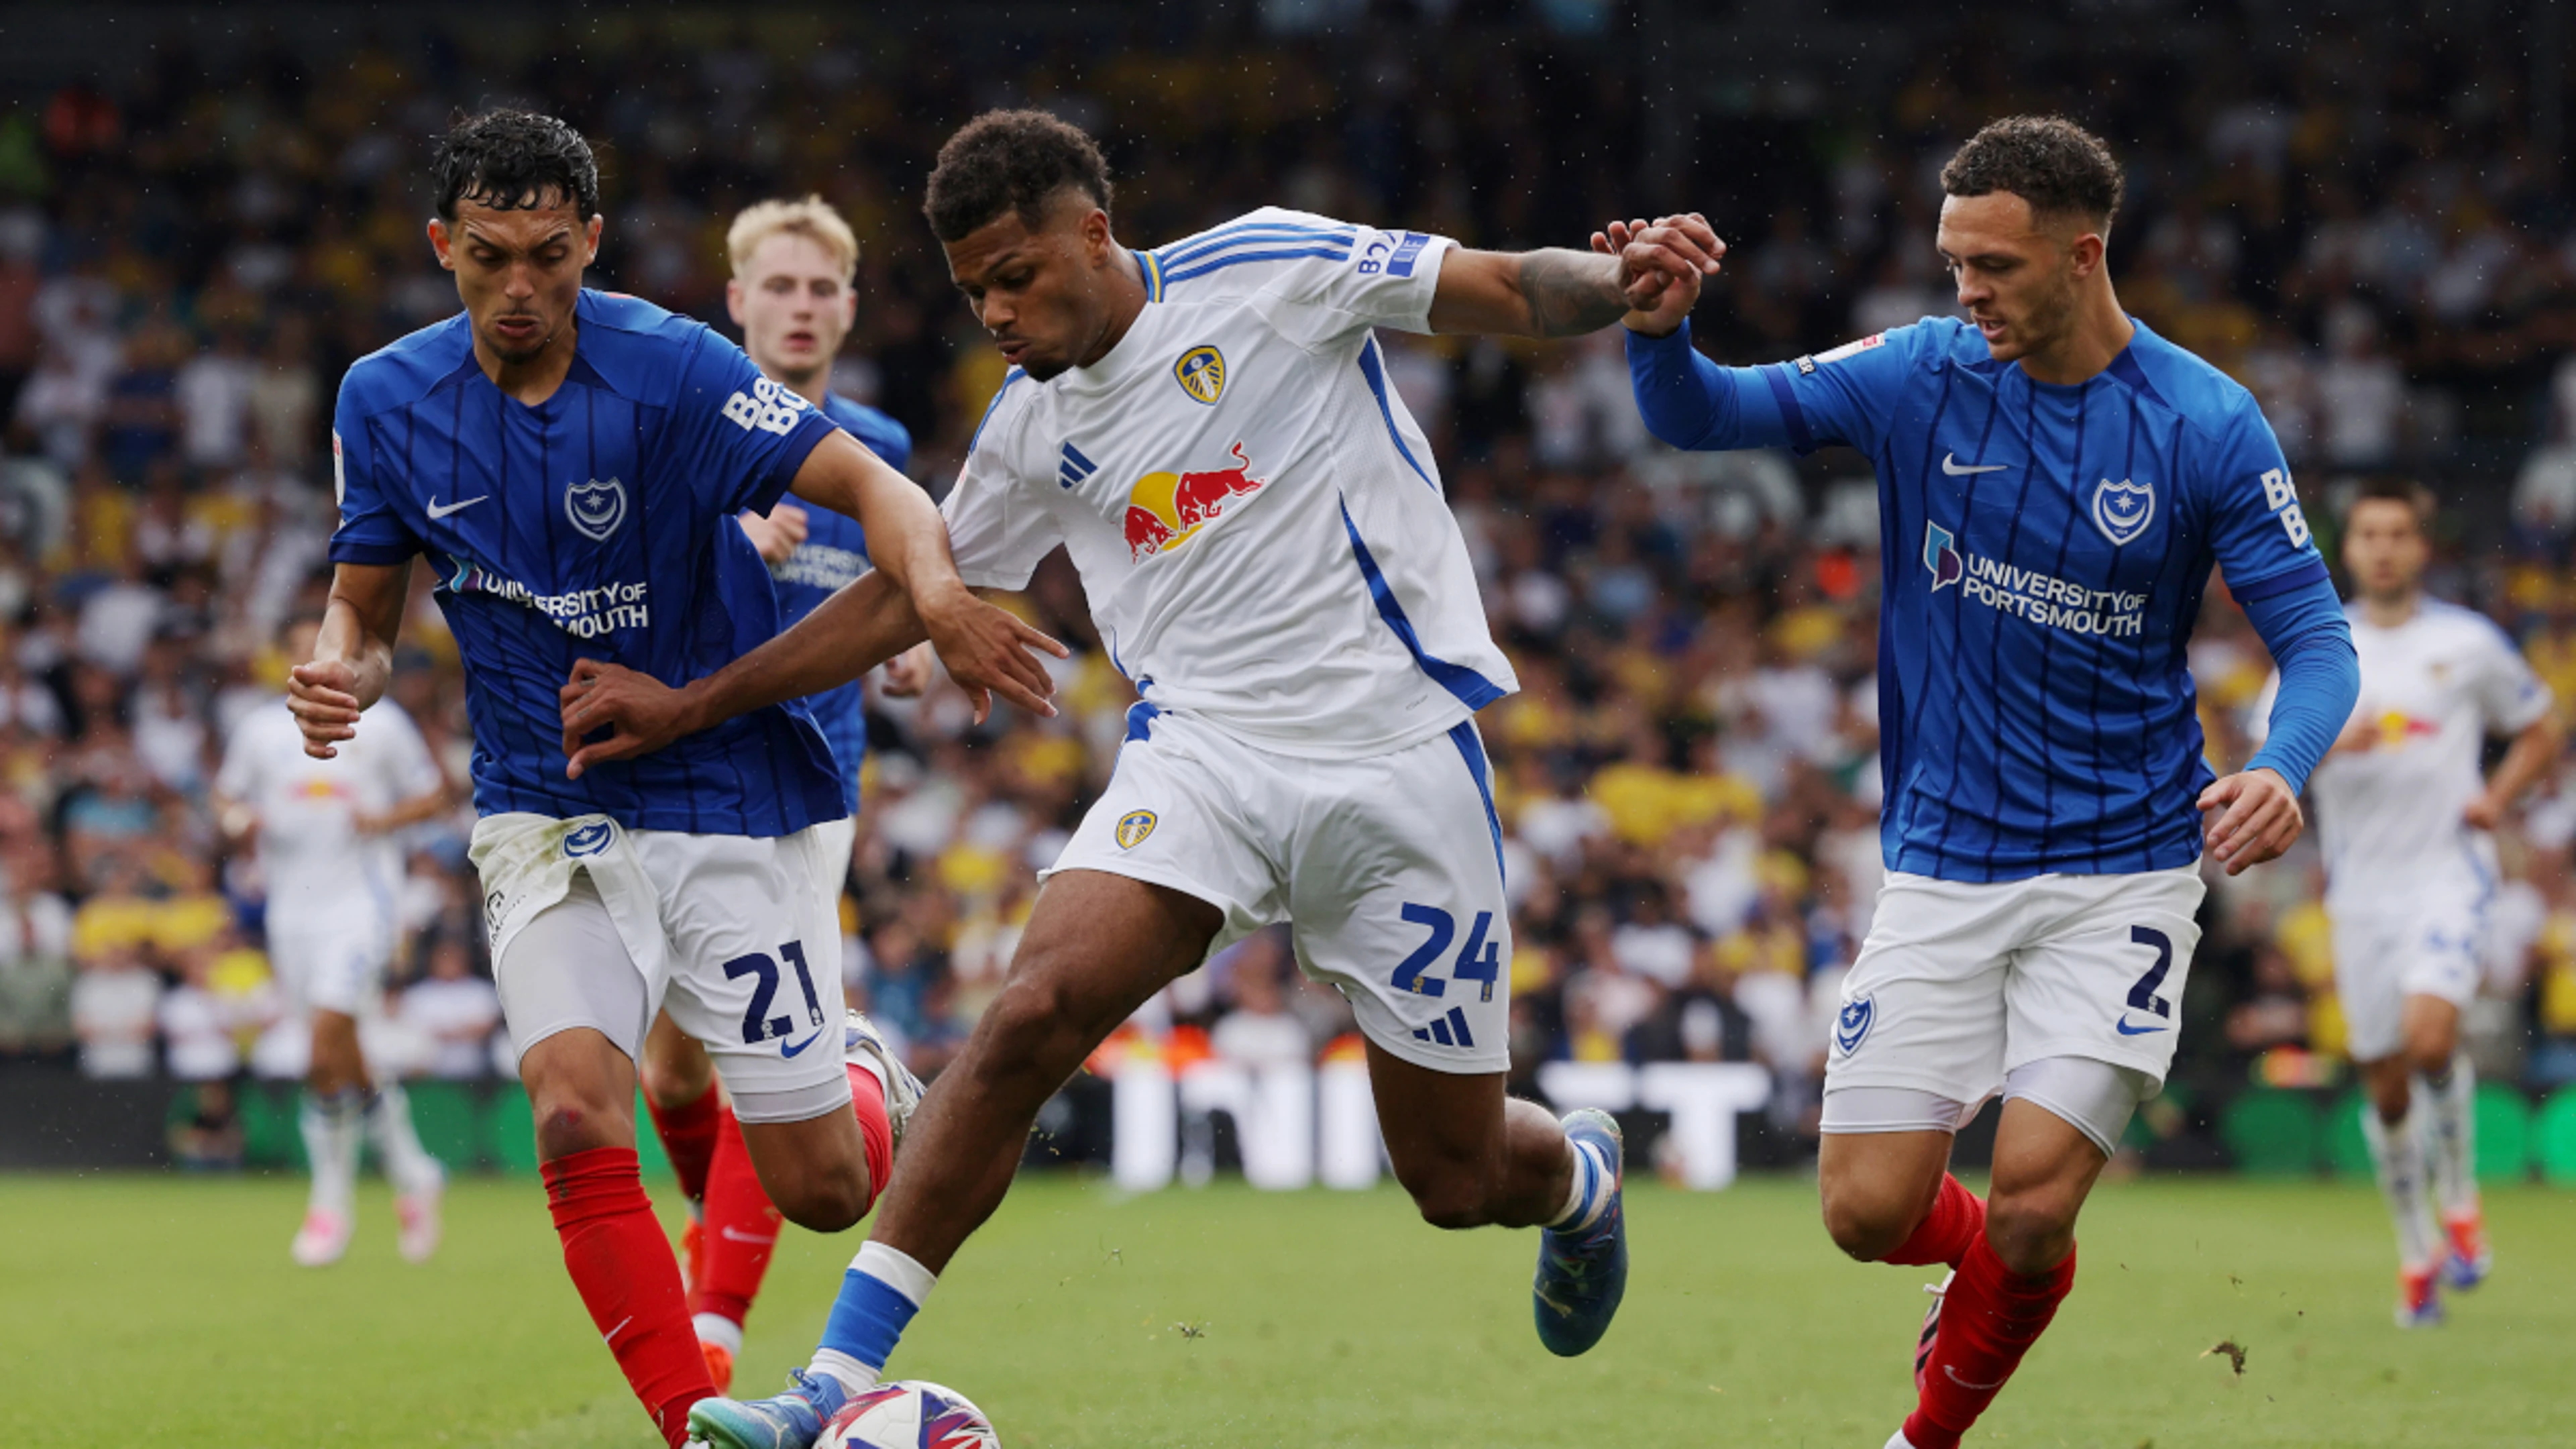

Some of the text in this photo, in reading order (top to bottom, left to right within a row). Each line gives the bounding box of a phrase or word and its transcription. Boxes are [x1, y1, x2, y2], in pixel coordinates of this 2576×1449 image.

[620, 582, 647, 602] OF
[1963, 576, 2143, 637] PORTSMOUTH
[1968, 553, 2148, 613] UNIVERSITY OF
[1391, 902, 1499, 1002] 24
[2127, 925, 2172, 1020] 2
[722, 940, 825, 1044] 21
